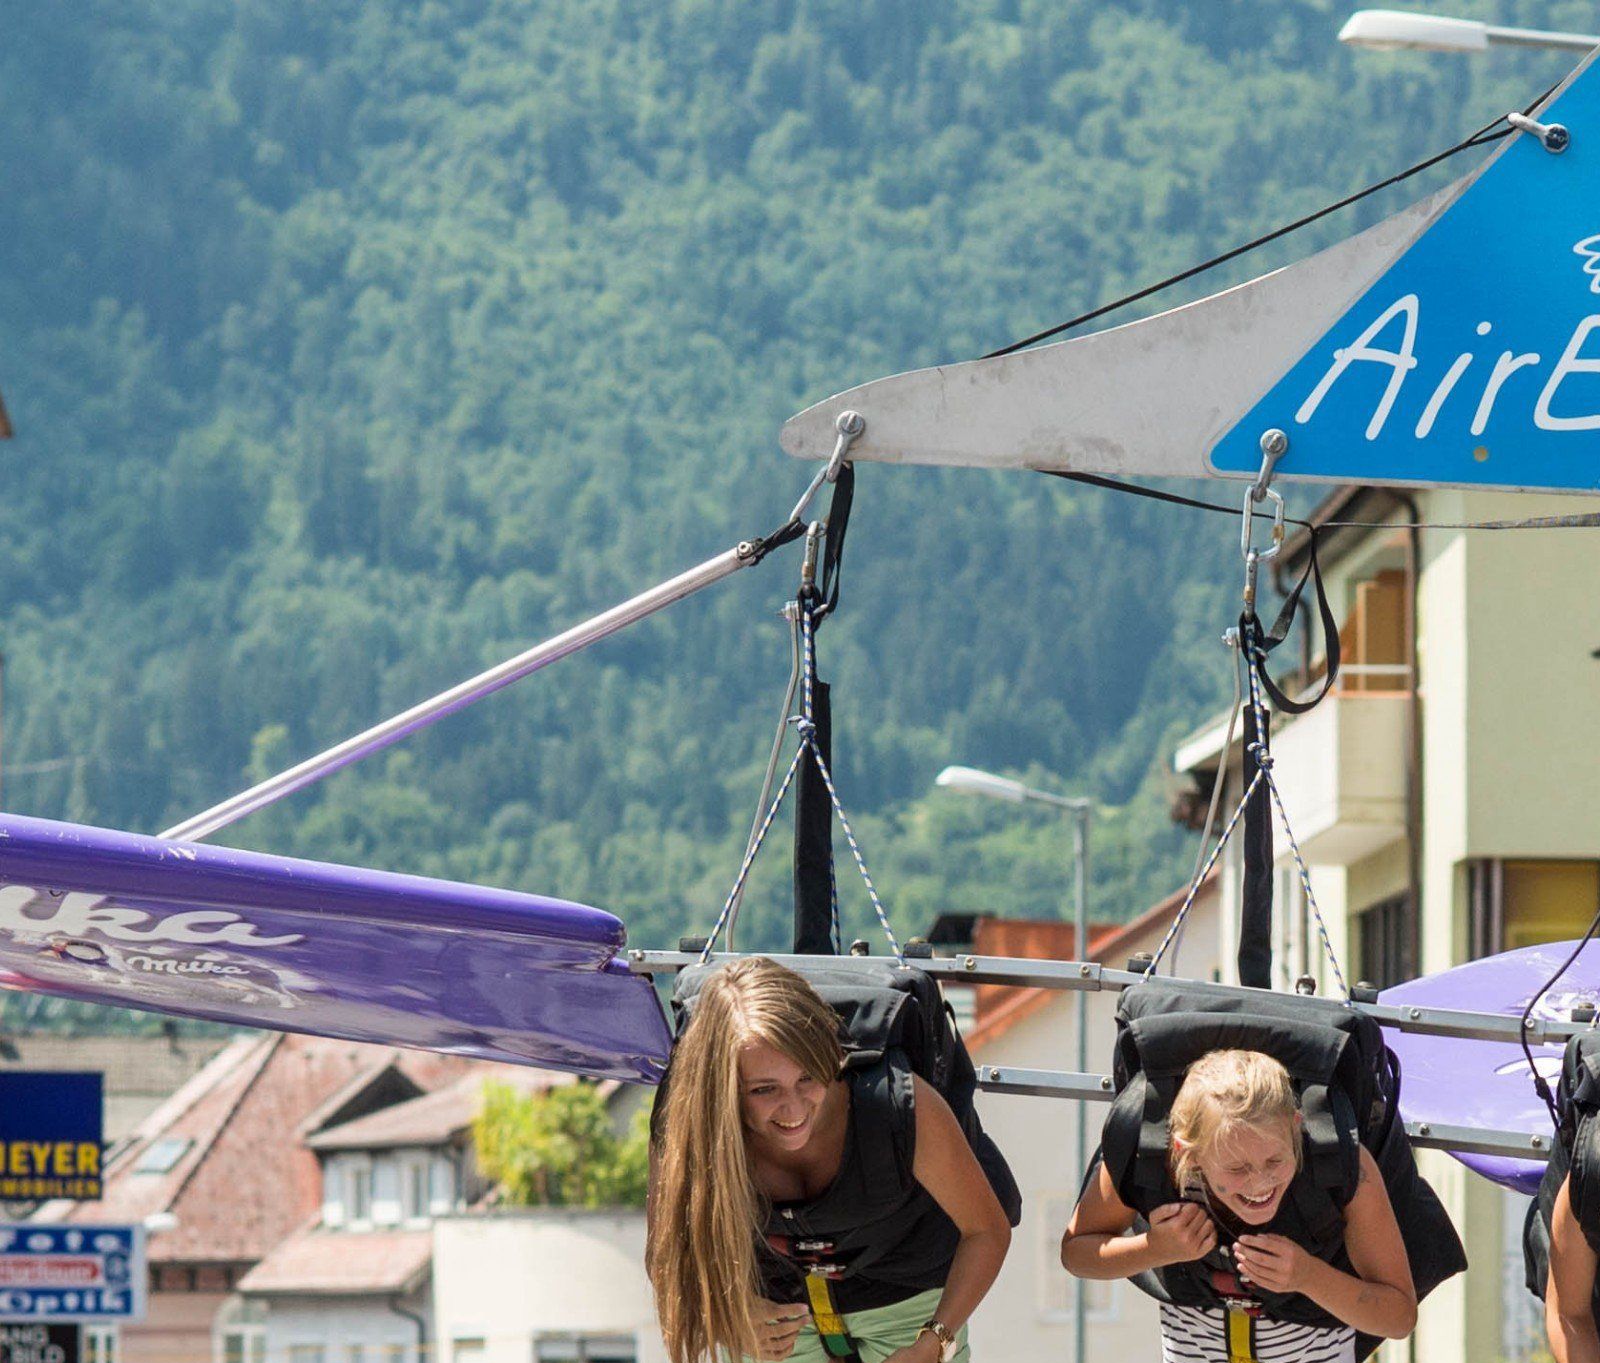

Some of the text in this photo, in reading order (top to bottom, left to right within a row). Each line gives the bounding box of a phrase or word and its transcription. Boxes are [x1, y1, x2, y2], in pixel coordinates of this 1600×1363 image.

[126, 955, 251, 976] Milka
[0, 1142, 100, 1176] EYER
[0, 1179, 100, 1197] MOBILIEN
[0, 1289, 125, 1315] Optik
